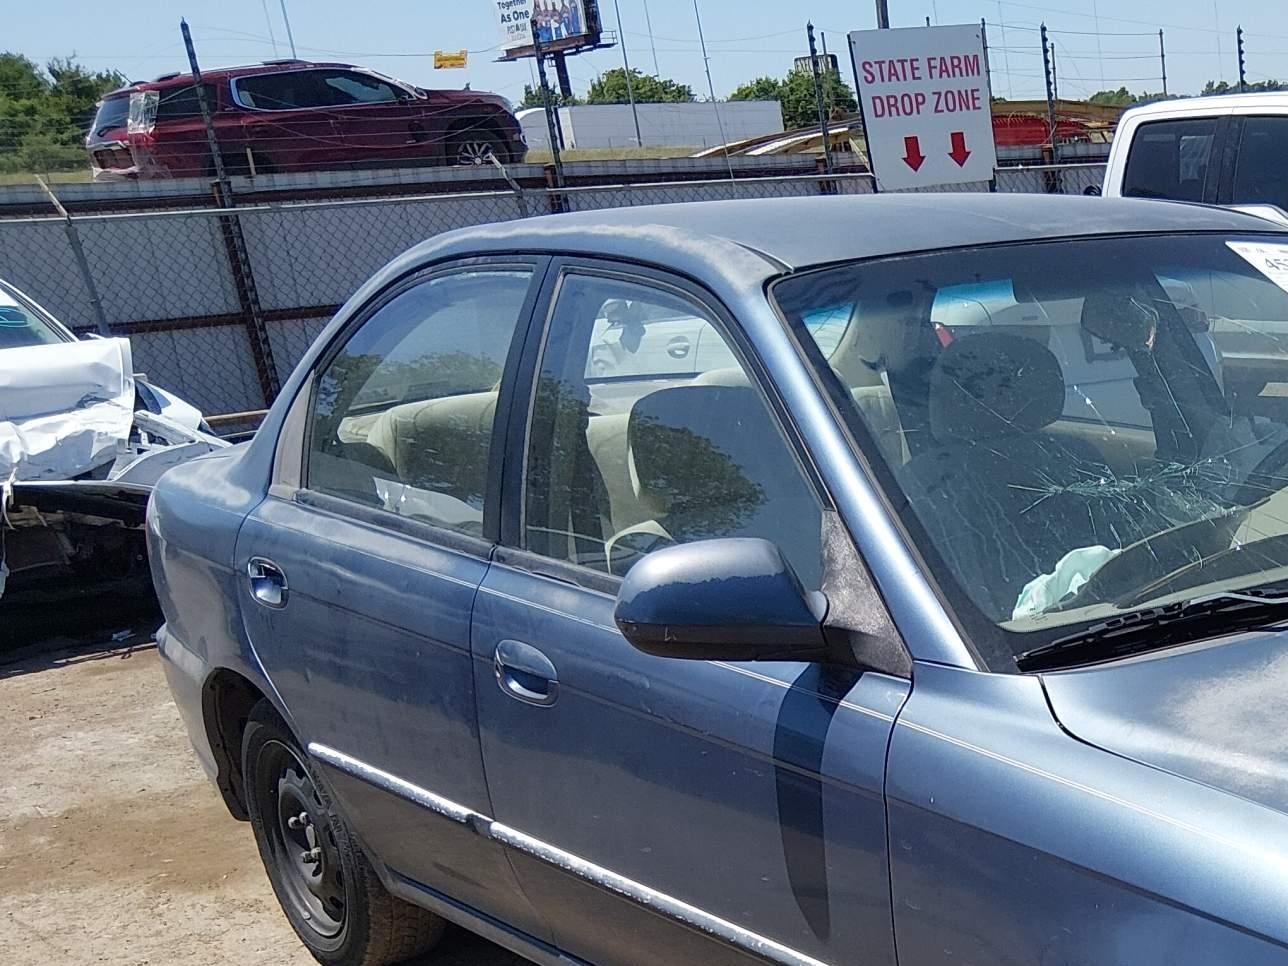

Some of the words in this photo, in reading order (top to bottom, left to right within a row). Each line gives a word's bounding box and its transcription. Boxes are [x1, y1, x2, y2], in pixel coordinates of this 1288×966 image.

[501, 13, 512, 24] As
[512, 9, 530, 21] One
[862, 58, 922, 84] STATE
[927, 54, 980, 80] FARM
[871, 92, 926, 118] DROP
[932, 88, 982, 114] ZONE
